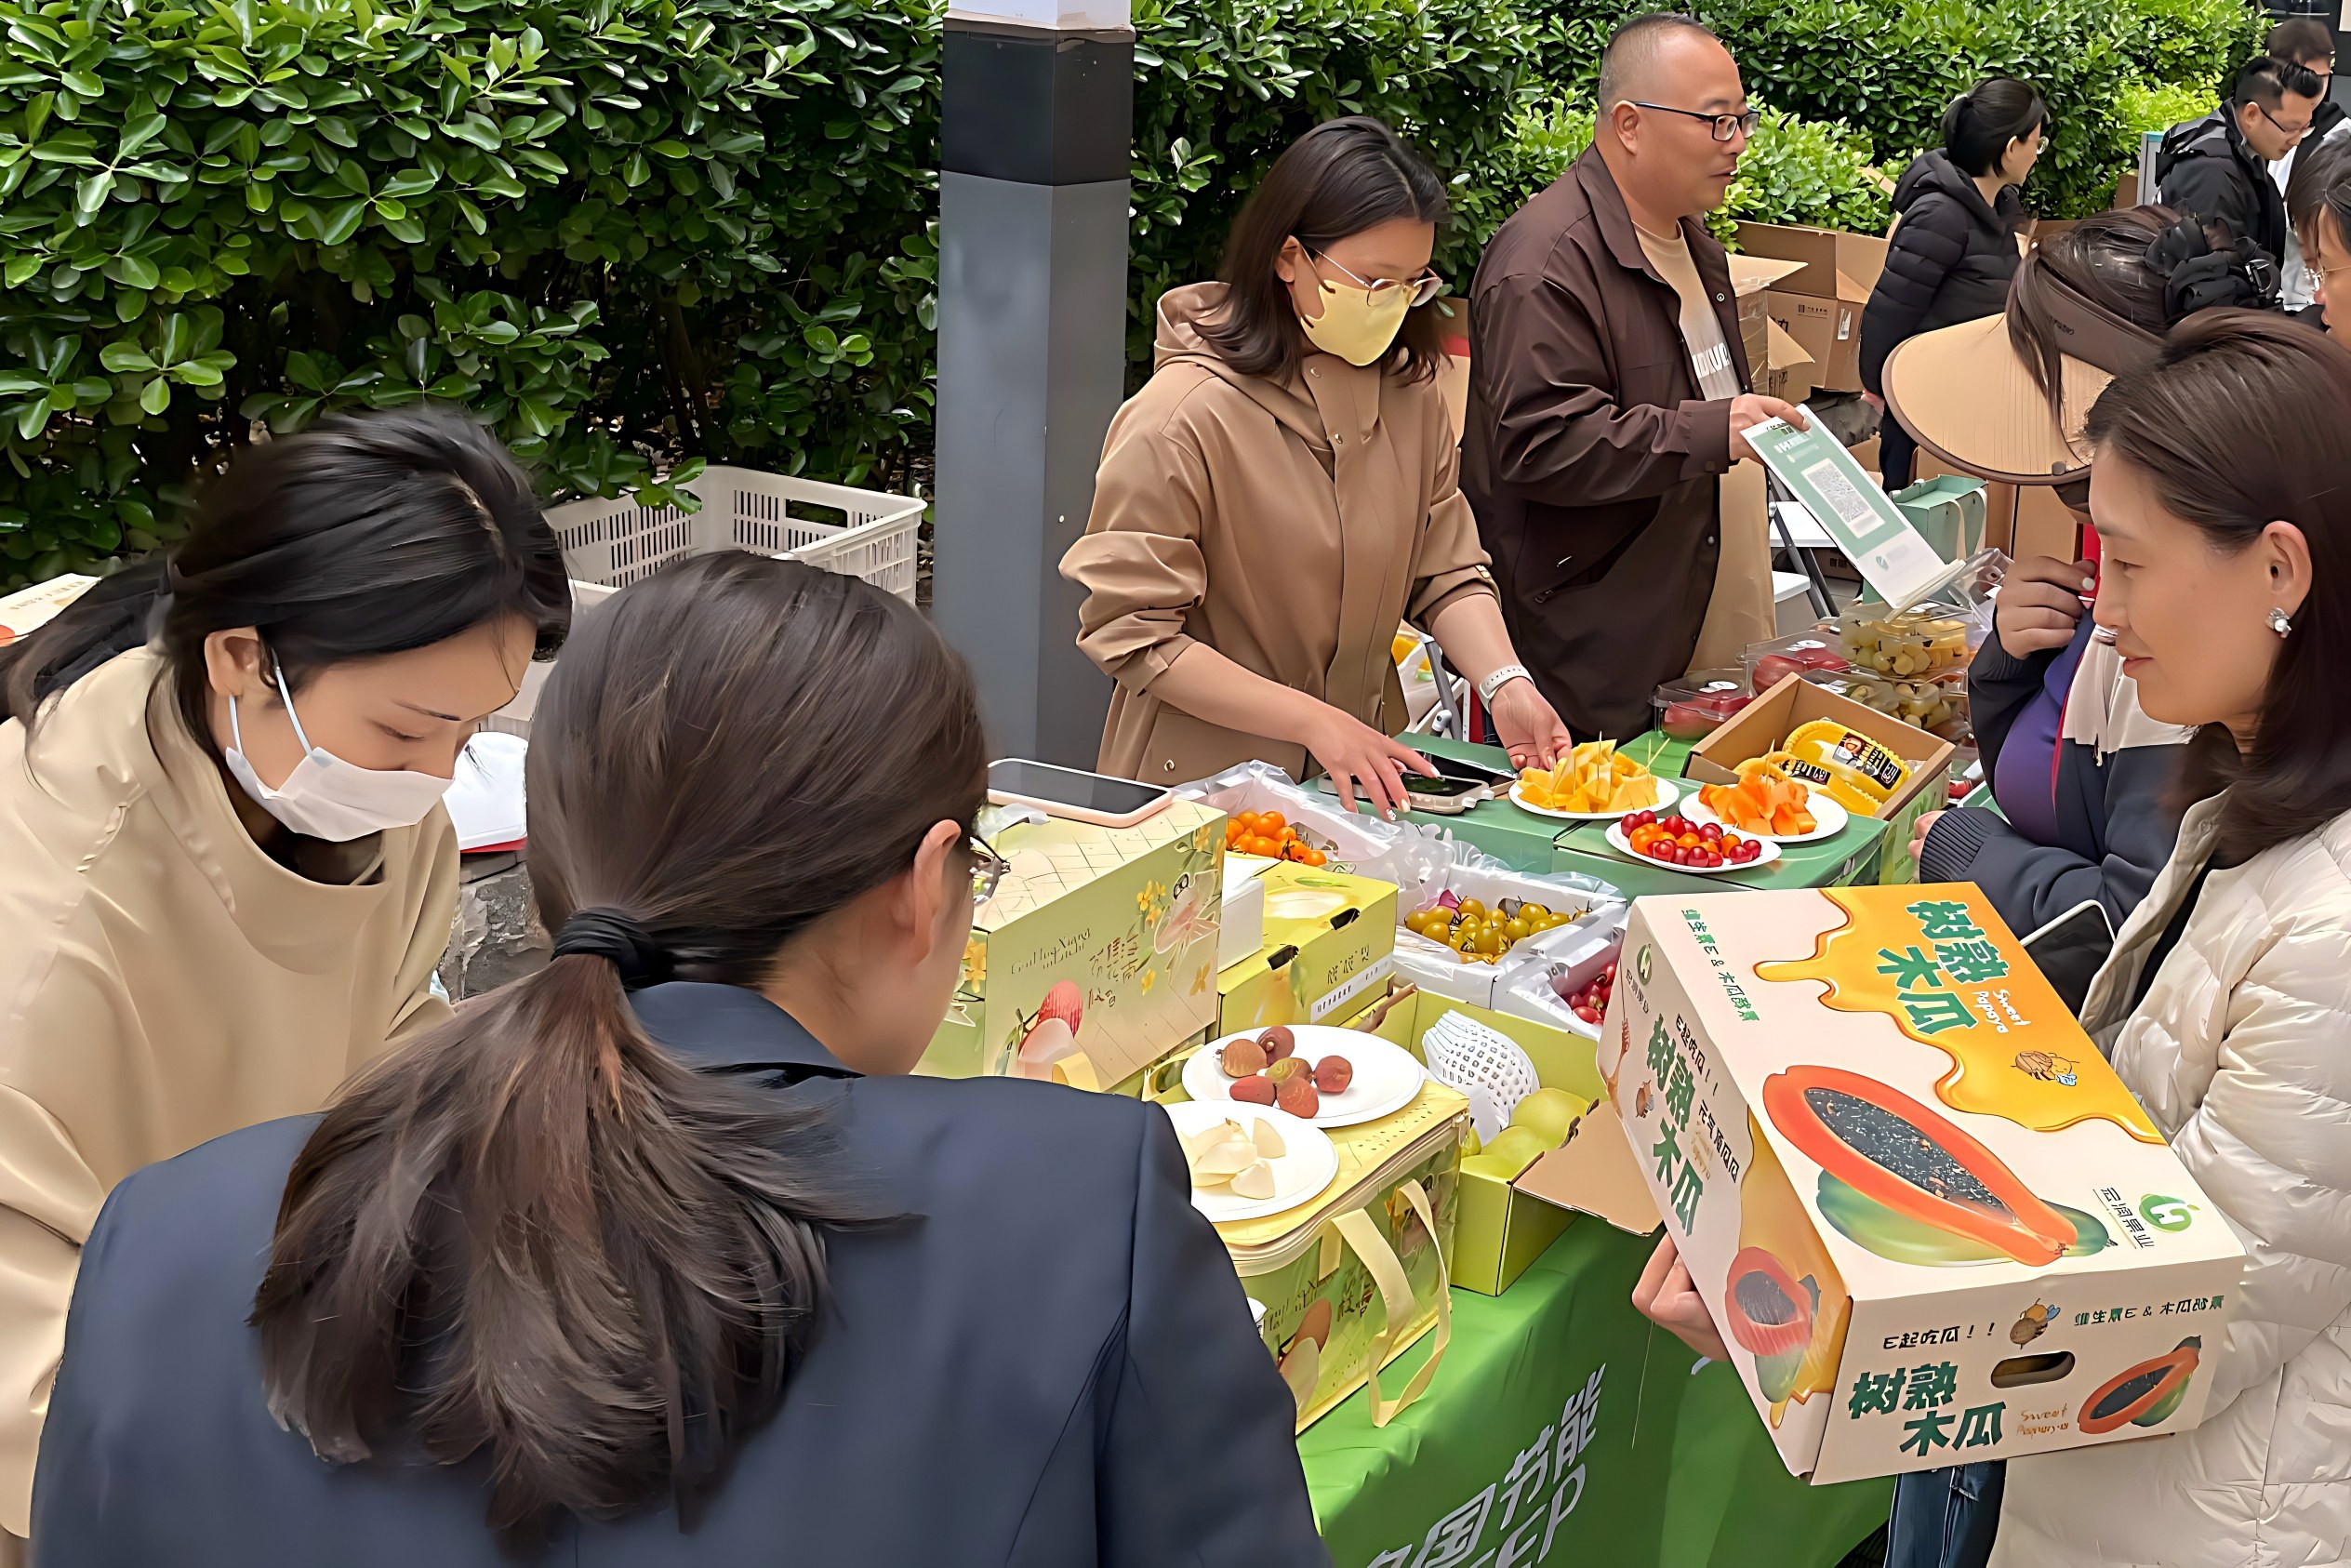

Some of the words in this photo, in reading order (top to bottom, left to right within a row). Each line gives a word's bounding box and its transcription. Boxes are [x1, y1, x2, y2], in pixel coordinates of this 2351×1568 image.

[1906, 901, 2009, 984] 树熟
[1877, 946, 1978, 1034] 木瓜
[1647, 1014, 1695, 1133] 树熟
[1654, 1117, 1703, 1237] 木瓜
[1848, 1362, 1959, 1419] 树熟
[1900, 1402, 2007, 1456] 木瓜
